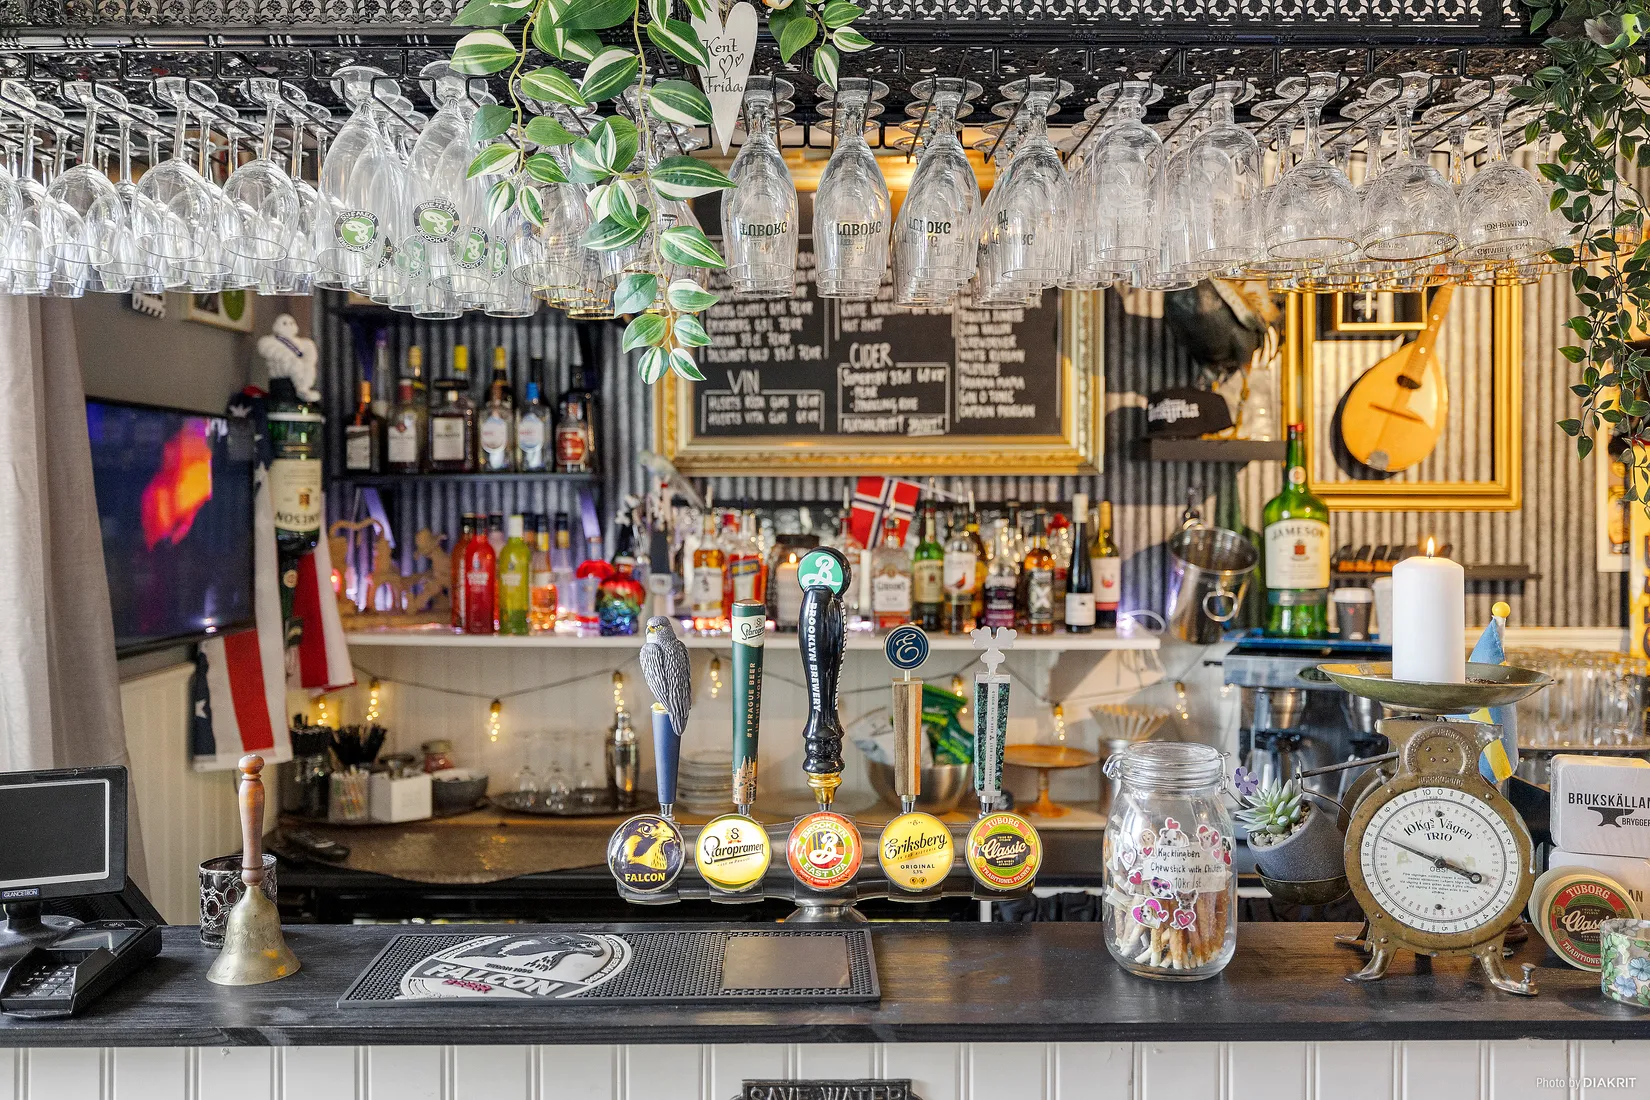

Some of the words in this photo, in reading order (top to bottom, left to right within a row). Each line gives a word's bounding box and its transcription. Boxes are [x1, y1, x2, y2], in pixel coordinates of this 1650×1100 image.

[702, 36, 738, 57] Kent
[703, 75, 743, 94] Frida
[848, 342, 894, 370] CIDER
[726, 368, 760, 396] VIN
[807, 602, 818, 662] BROOKLYN
[748, 662, 756, 685] BEER
[809, 664, 821, 713] BREWERY
[747, 690, 755, 724] PRAGUE
[802, 821, 849, 838] BROOKLYN
[985, 817, 1020, 829] TUBORG
[1440, 818, 1473, 840] Vägen
[884, 832, 948, 860] Eriksberg
[1424, 832, 1453, 841] TRIO
[703, 835, 766, 865] Staropramen
[981, 838, 1027, 860] Classic
[624, 873, 666, 883] FALCON
[803, 862, 829, 878] EAST
[831, 862, 848, 876] IPA
[1565, 884, 1611, 900] TUBORG
[1562, 941, 1601, 965] TRADITIONE
[422, 963, 564, 997] FALCON
